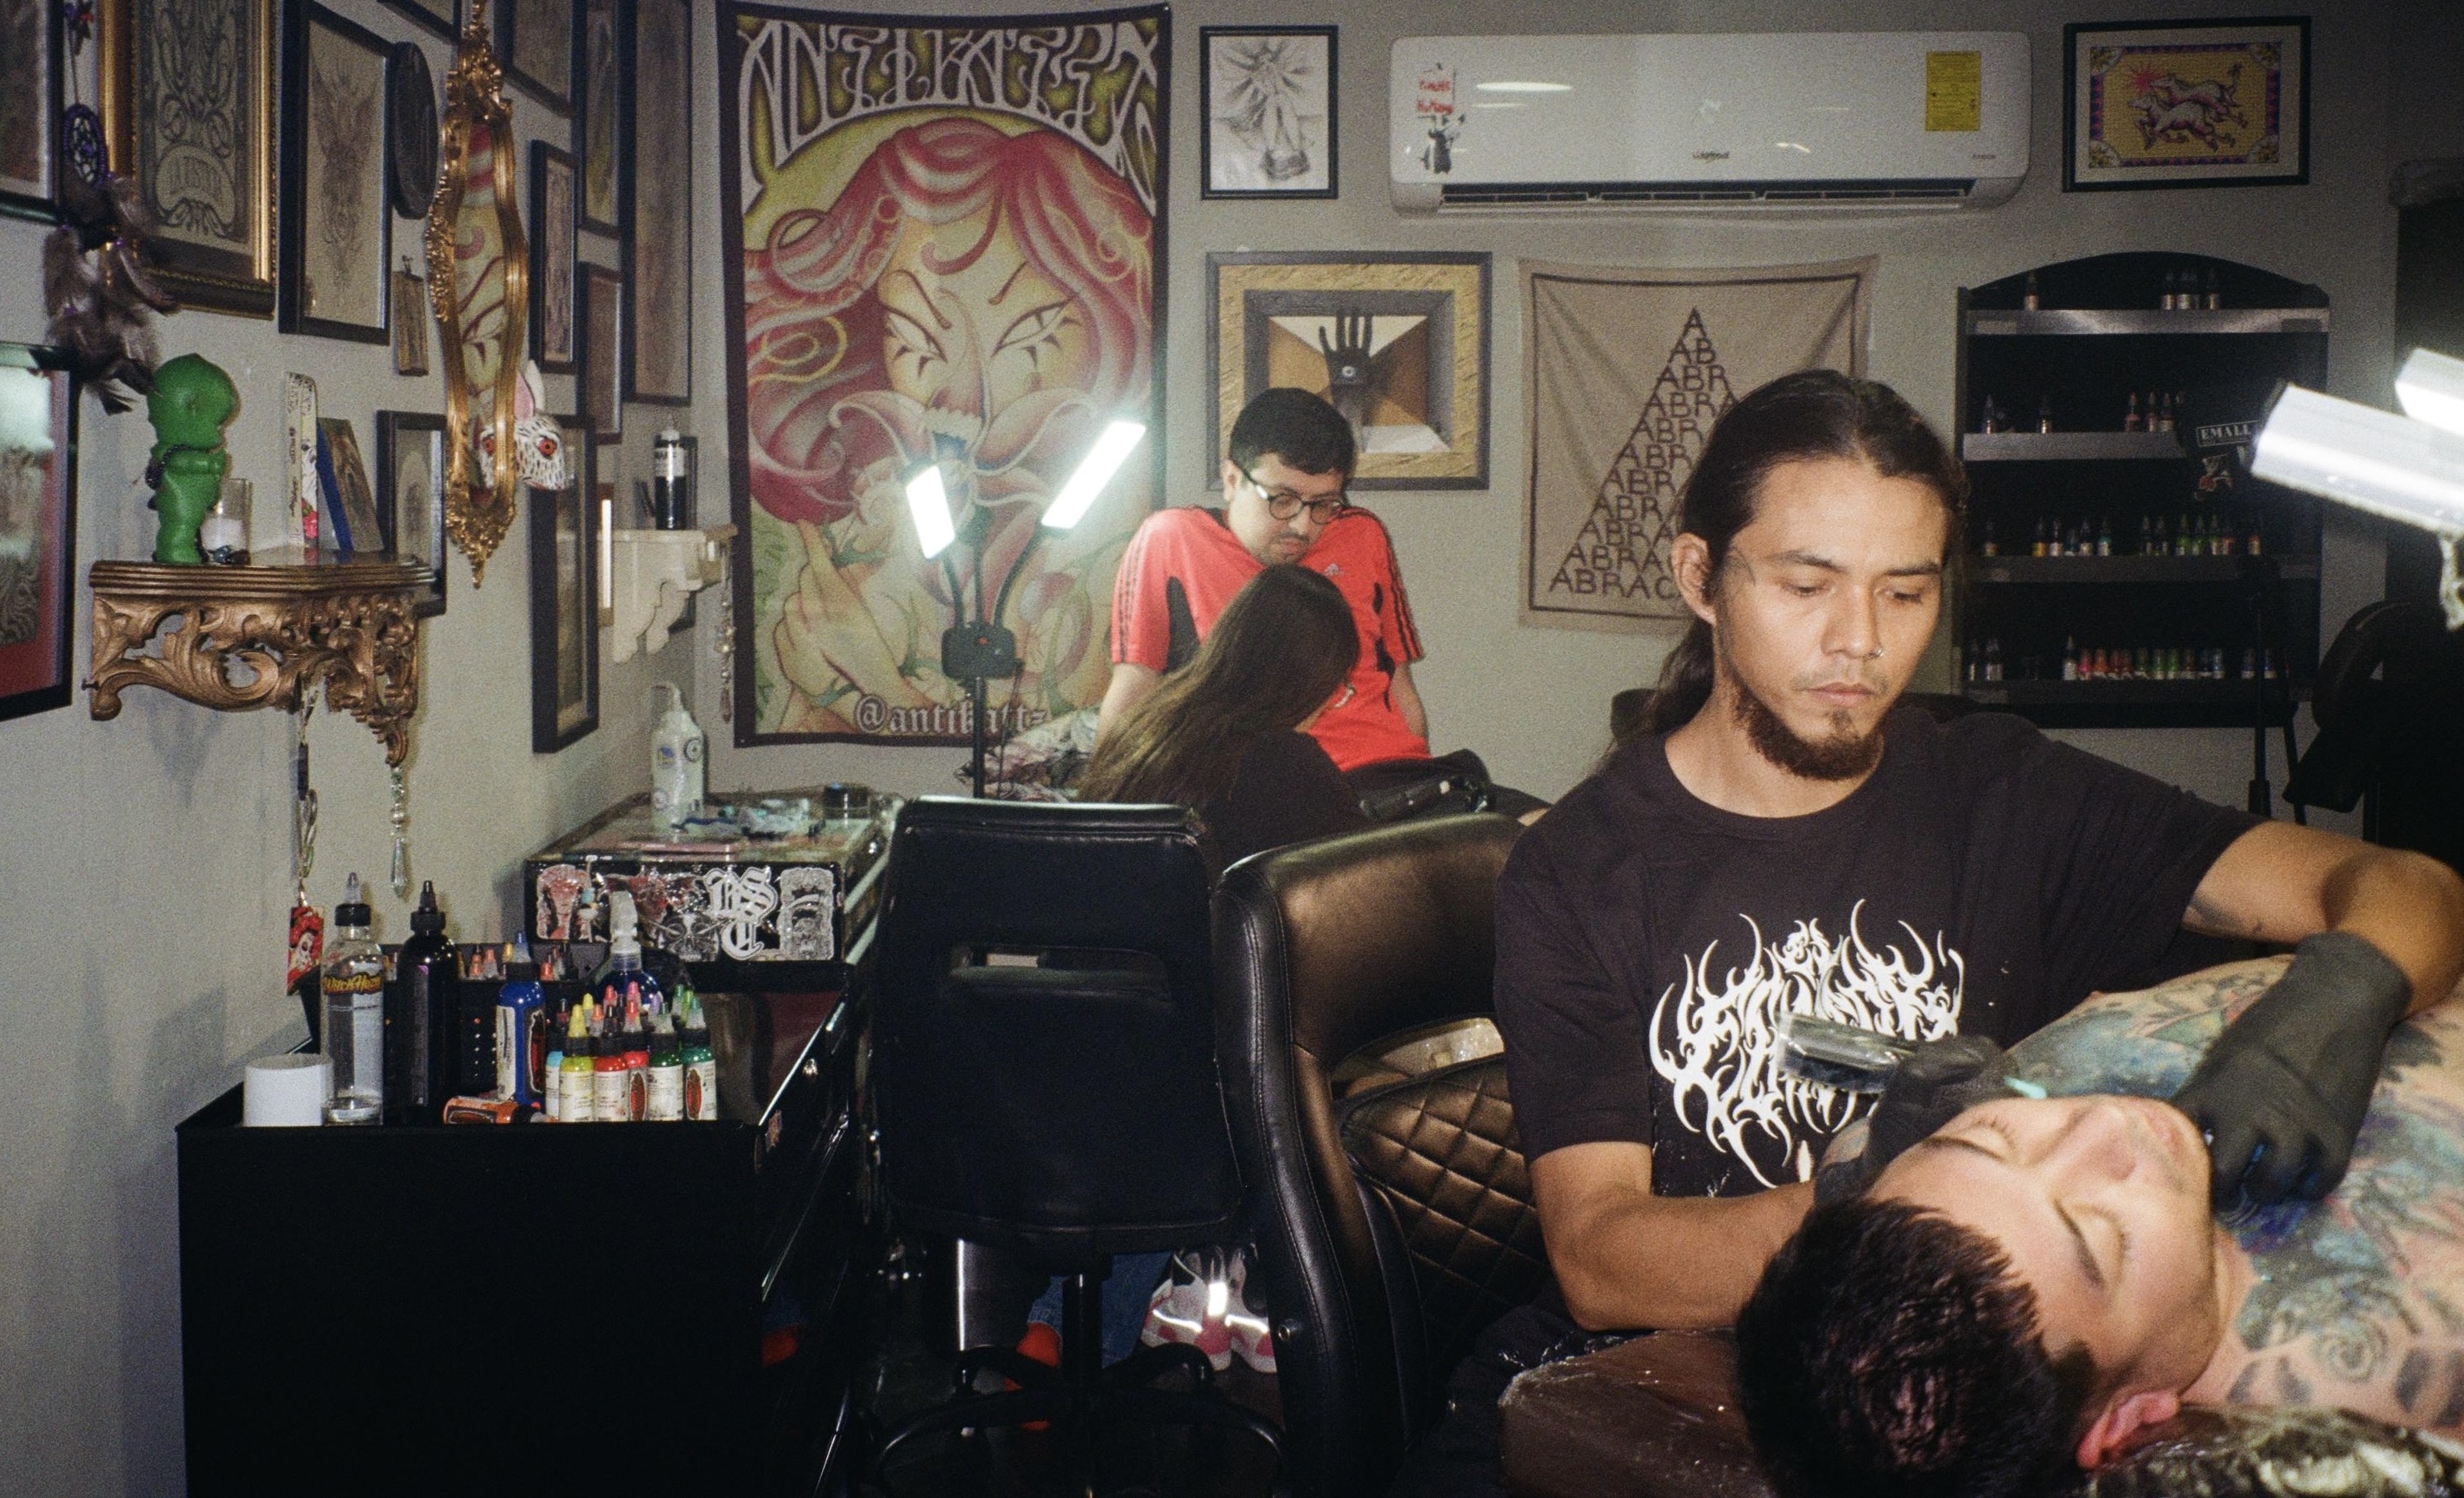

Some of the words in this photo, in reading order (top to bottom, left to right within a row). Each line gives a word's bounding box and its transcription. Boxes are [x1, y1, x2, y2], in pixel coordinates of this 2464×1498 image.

[1681, 307, 1707, 337] A
[1668, 337, 1716, 364] AB
[1654, 364, 1730, 392] ABR
[1628, 417, 1704, 445] ABR
[1614, 442, 1693, 470] ABR
[1601, 467, 1678, 495] ABR
[1577, 517, 1674, 548] ABRA
[1561, 541, 1674, 576] ABRA
[1548, 567, 1683, 601] ABRAC
